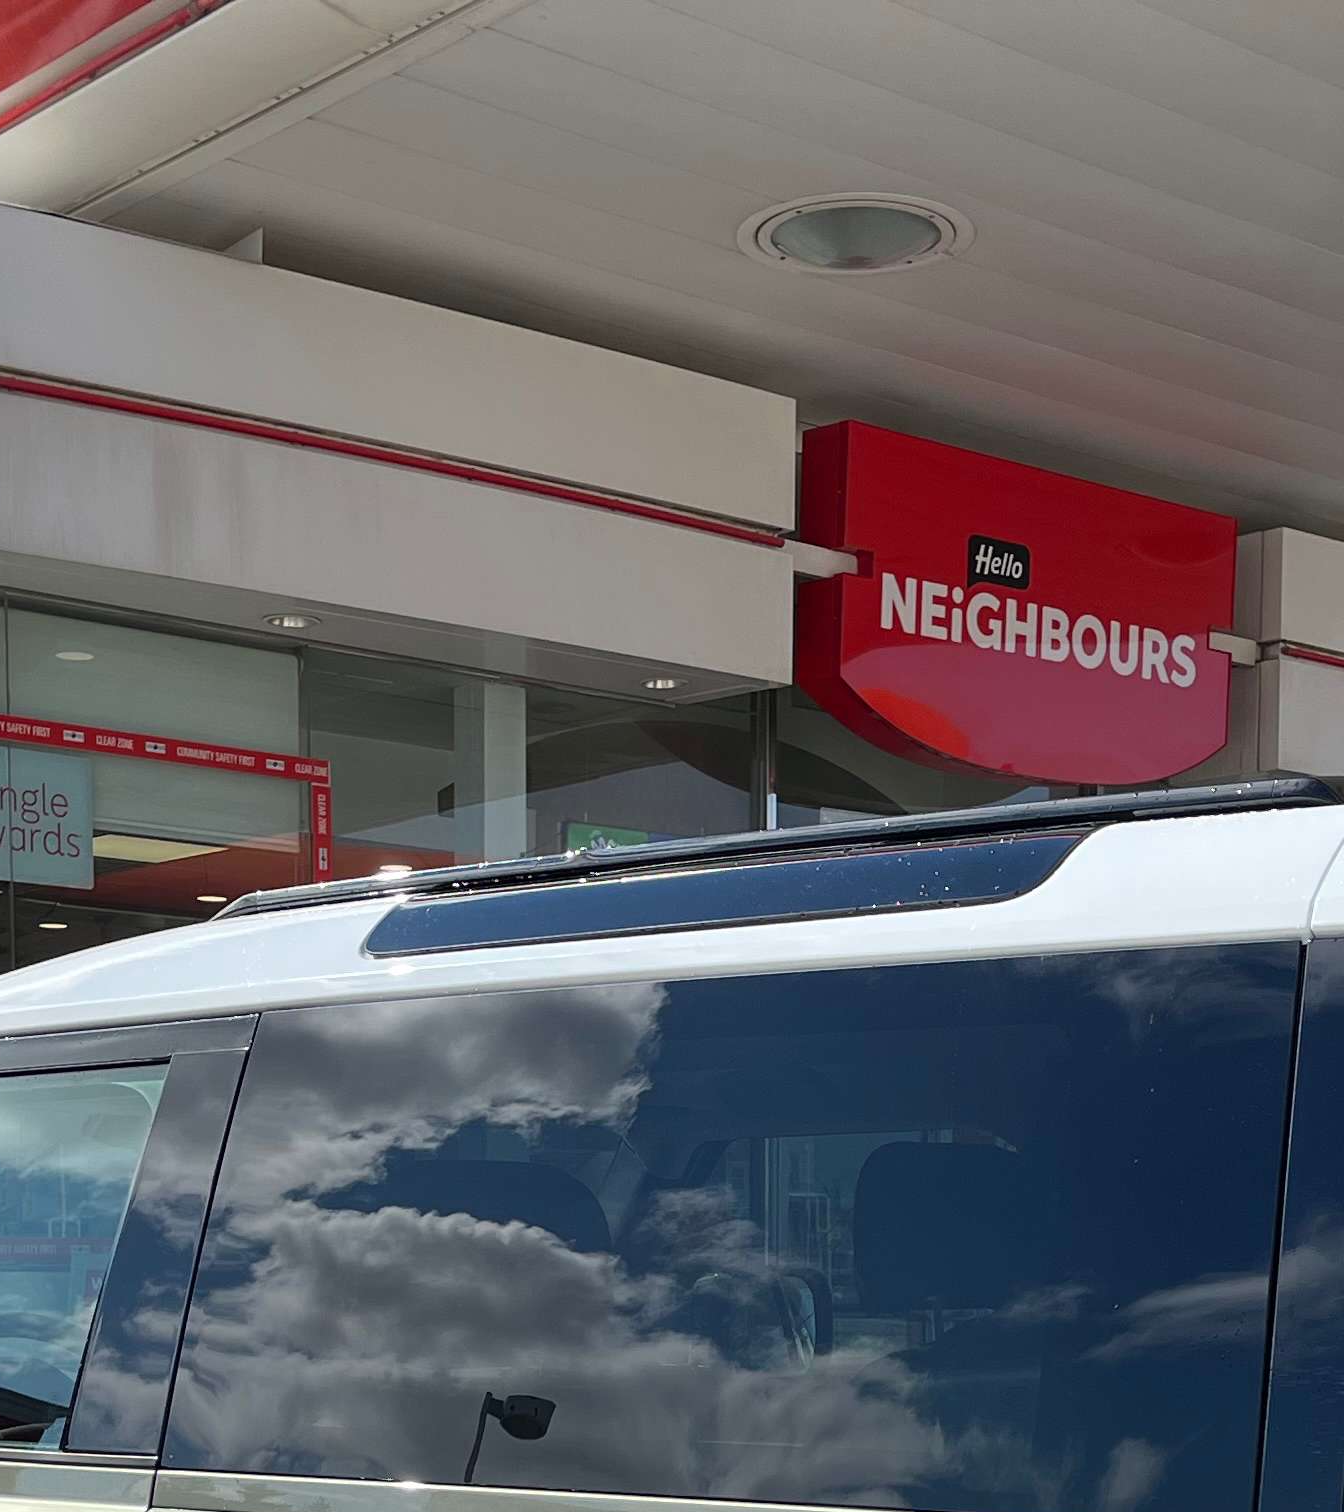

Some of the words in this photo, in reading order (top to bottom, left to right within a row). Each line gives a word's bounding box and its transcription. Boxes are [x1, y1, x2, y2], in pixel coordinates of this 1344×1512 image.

[975, 543, 1023, 579] Hello
[96, 735, 116, 747] CLEAR
[117, 737, 135, 751] ZONE
